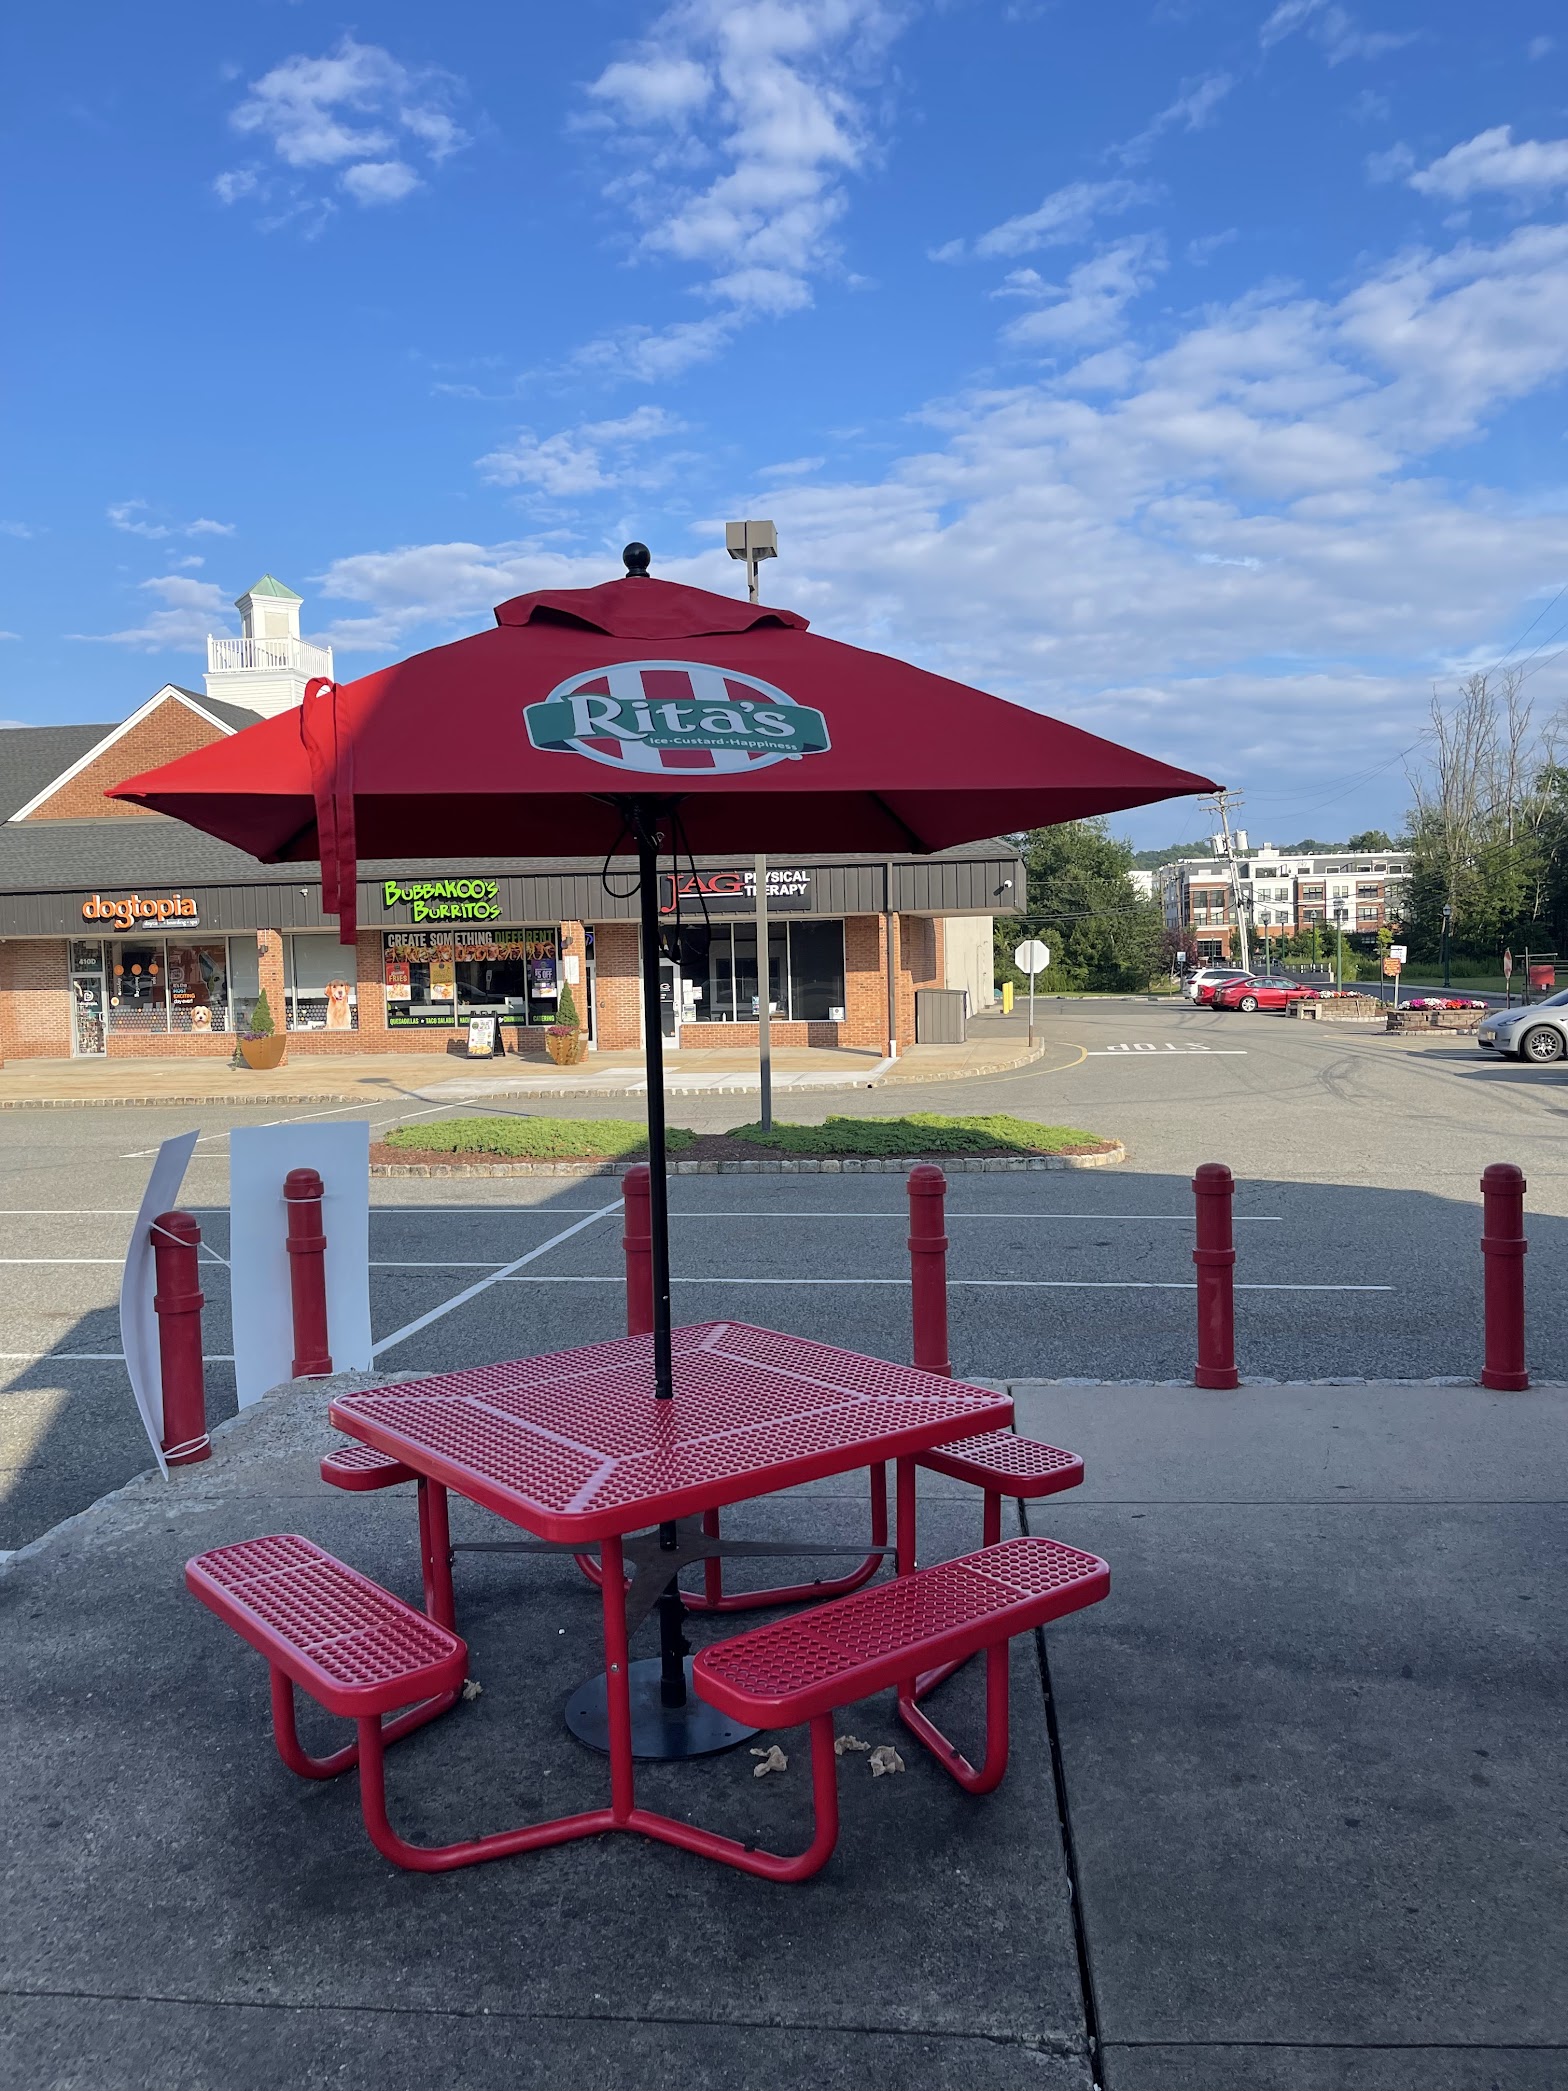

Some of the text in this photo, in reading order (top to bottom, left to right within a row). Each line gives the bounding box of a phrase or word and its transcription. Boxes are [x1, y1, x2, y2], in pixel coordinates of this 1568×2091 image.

[570, 694, 796, 741] Rita's
[384, 879, 499, 906] BUBBAKOO'S
[660, 873, 745, 914] JAG
[82, 894, 197, 928] dogtopia
[413, 900, 501, 922] BURRITOS
[387, 930, 554, 947] CREATE SOMETHING DIFFERENT
[542, 970, 552, 979] OFF
[389, 1017, 419, 1025] QUESADILLAS
[438, 1016, 454, 1024] SALADS
[533, 1014, 554, 1022] CATERING
